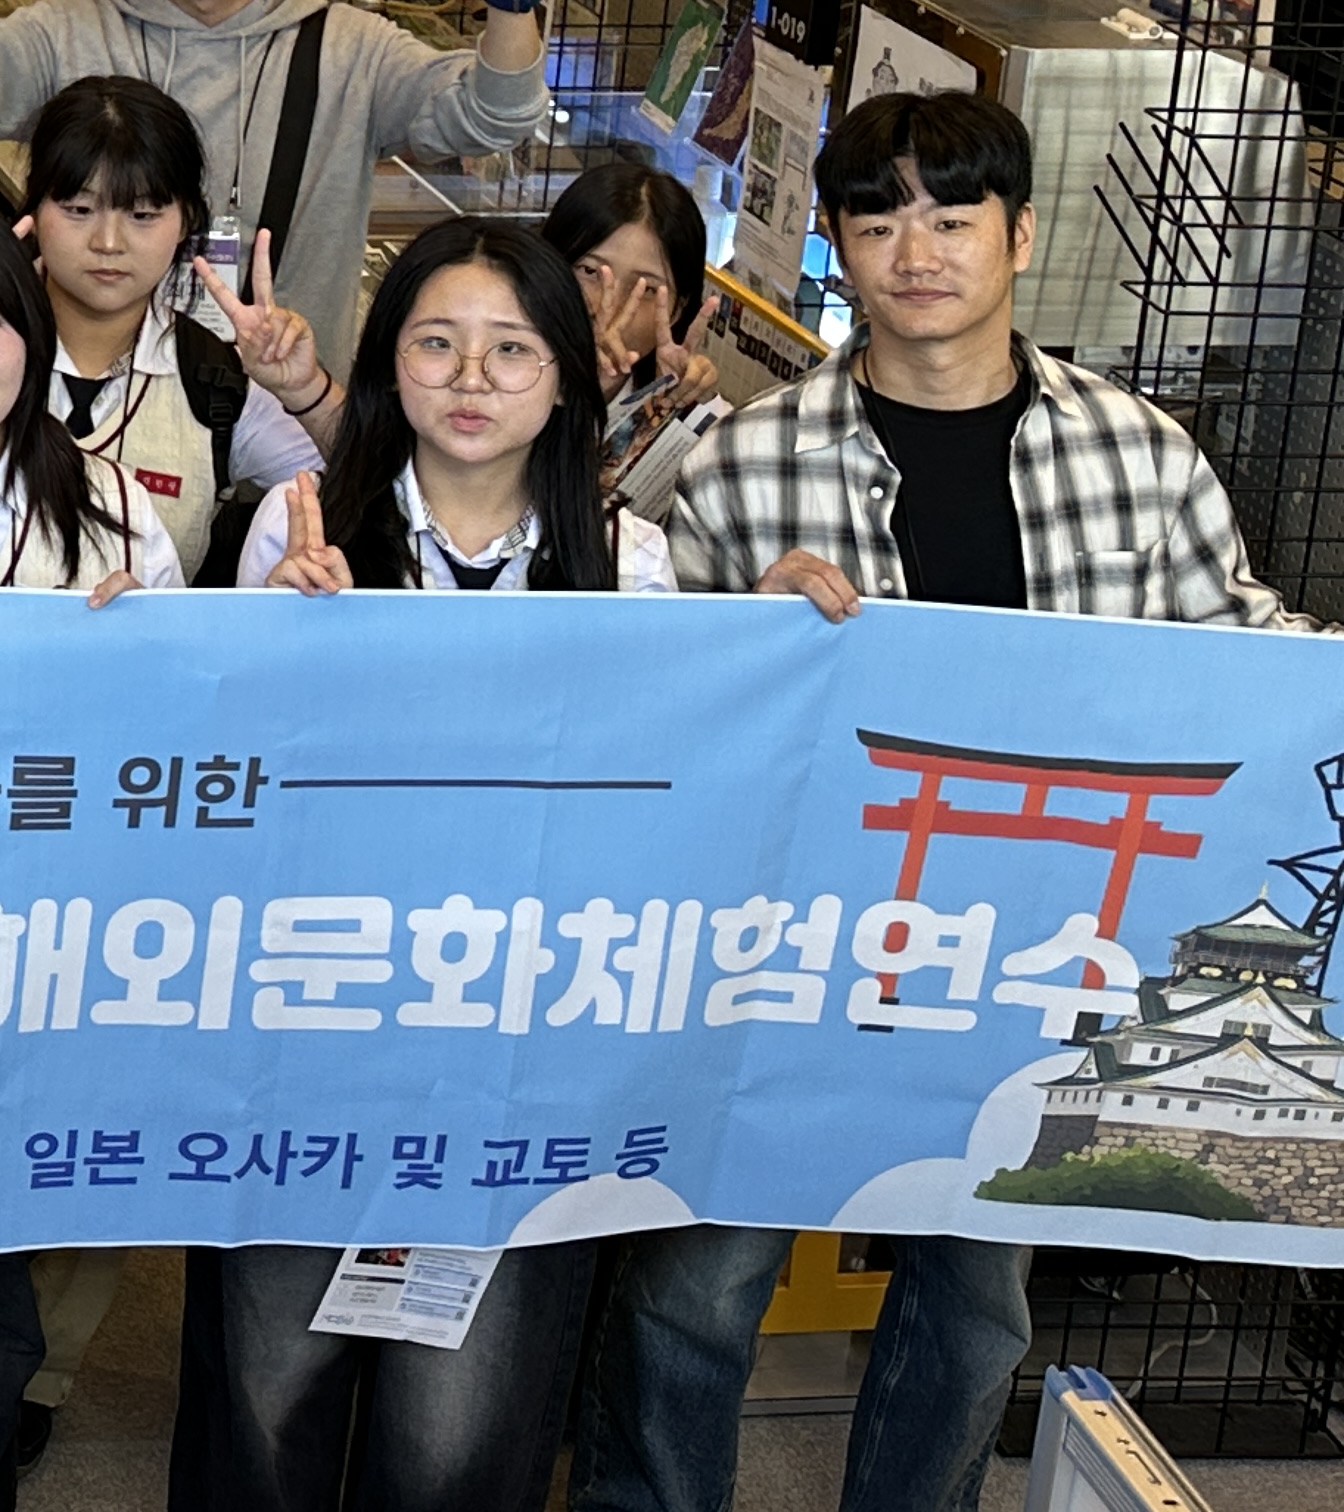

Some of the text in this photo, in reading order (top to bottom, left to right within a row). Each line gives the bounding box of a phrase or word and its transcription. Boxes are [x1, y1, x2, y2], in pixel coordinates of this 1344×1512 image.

[770, 6, 806, 44] 1-019
[112, 754, 269, 829] 위한
[24, 1128, 146, 1190] 일본
[168, 1129, 365, 1190] 오사카
[391, 1133, 449, 1191] 및
[471, 1136, 593, 1189] 교토
[614, 1124, 670, 1180] 등
